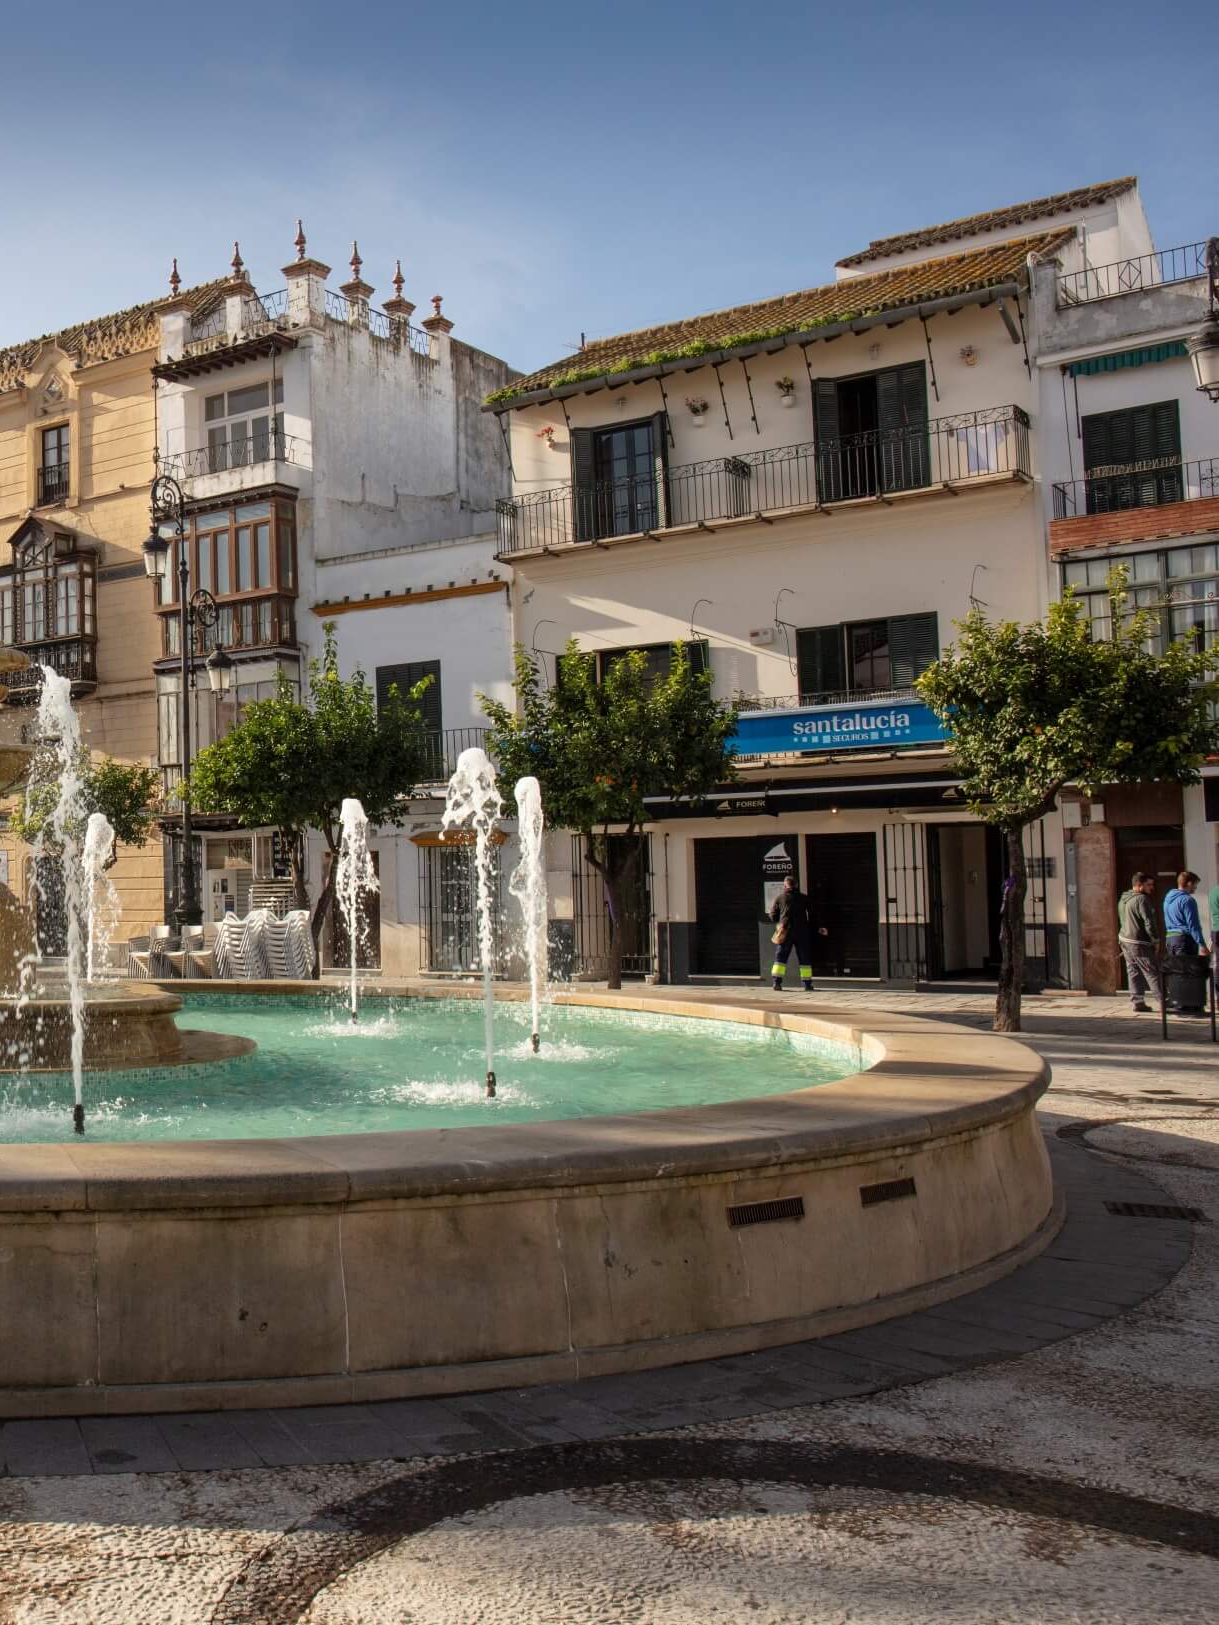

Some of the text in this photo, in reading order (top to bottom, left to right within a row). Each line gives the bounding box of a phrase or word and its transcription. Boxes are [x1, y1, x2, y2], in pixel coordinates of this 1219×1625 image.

[793, 710, 910, 735] santalucía
[832, 734, 870, 743] SEGUROS
[762, 862, 793, 871] FOREÑO
